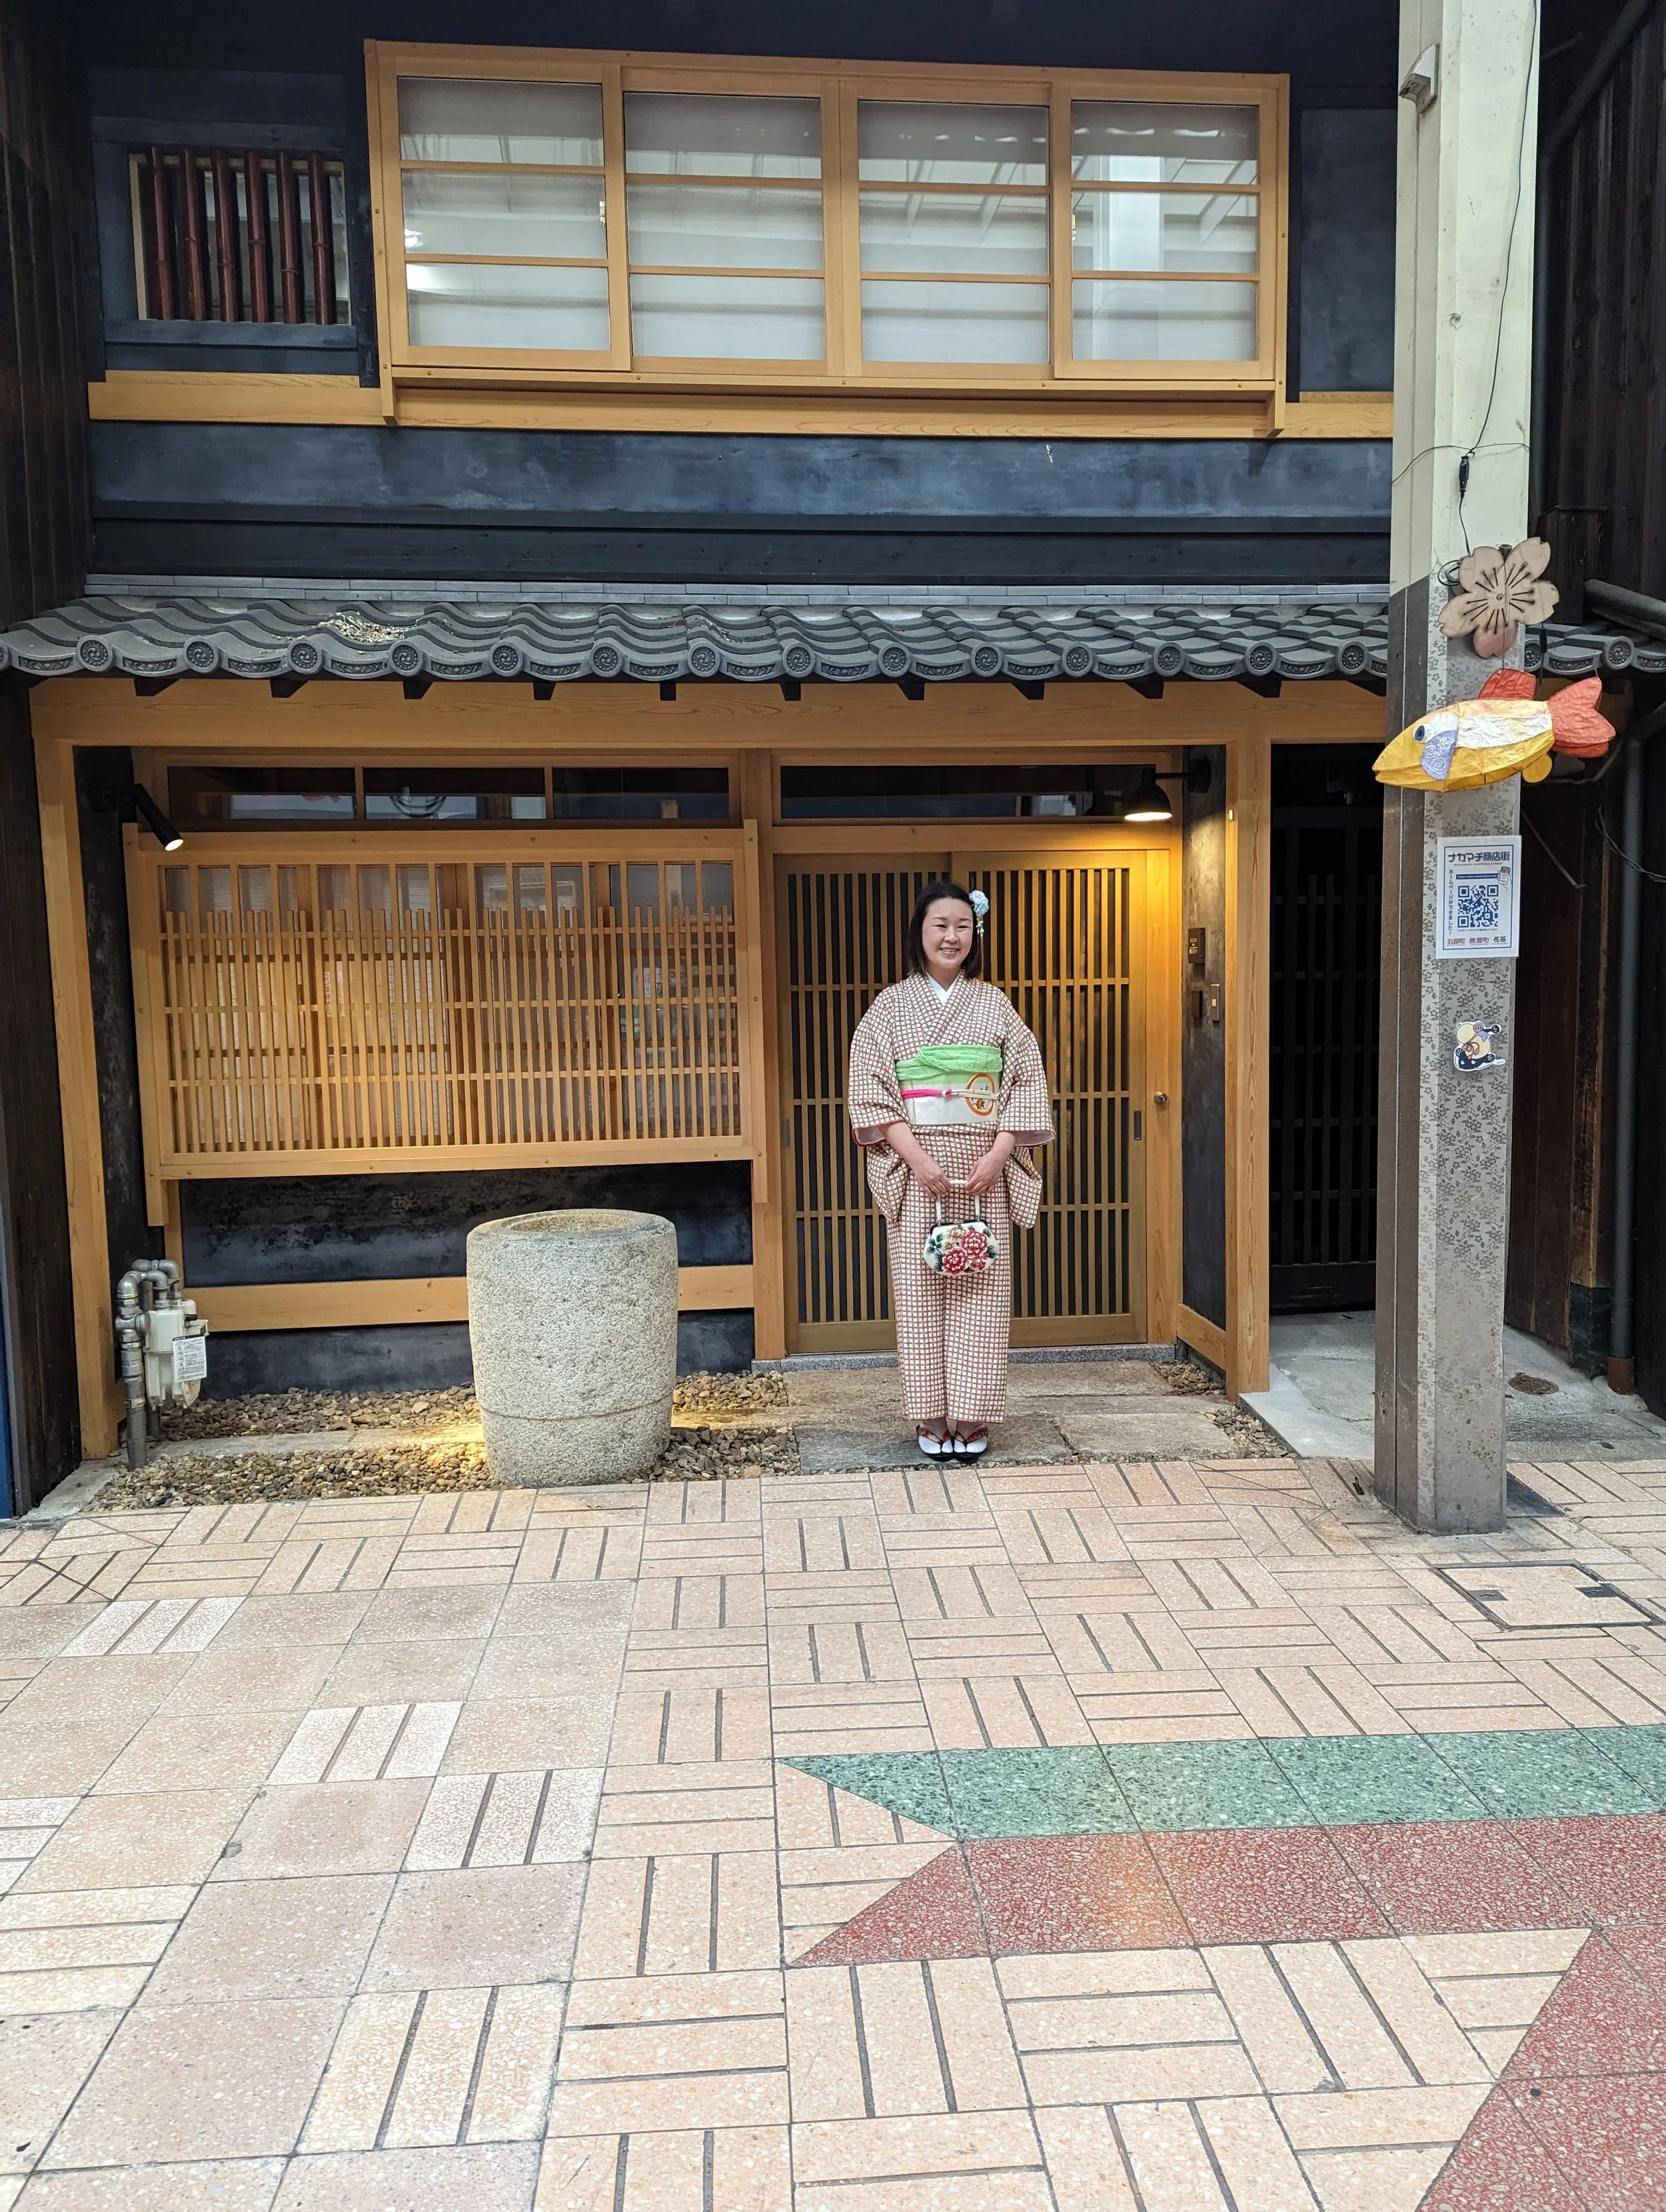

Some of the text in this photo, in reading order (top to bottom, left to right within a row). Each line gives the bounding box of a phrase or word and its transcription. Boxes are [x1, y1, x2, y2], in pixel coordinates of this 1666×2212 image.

[1447, 851, 1510, 862] ナカマチ商店街
